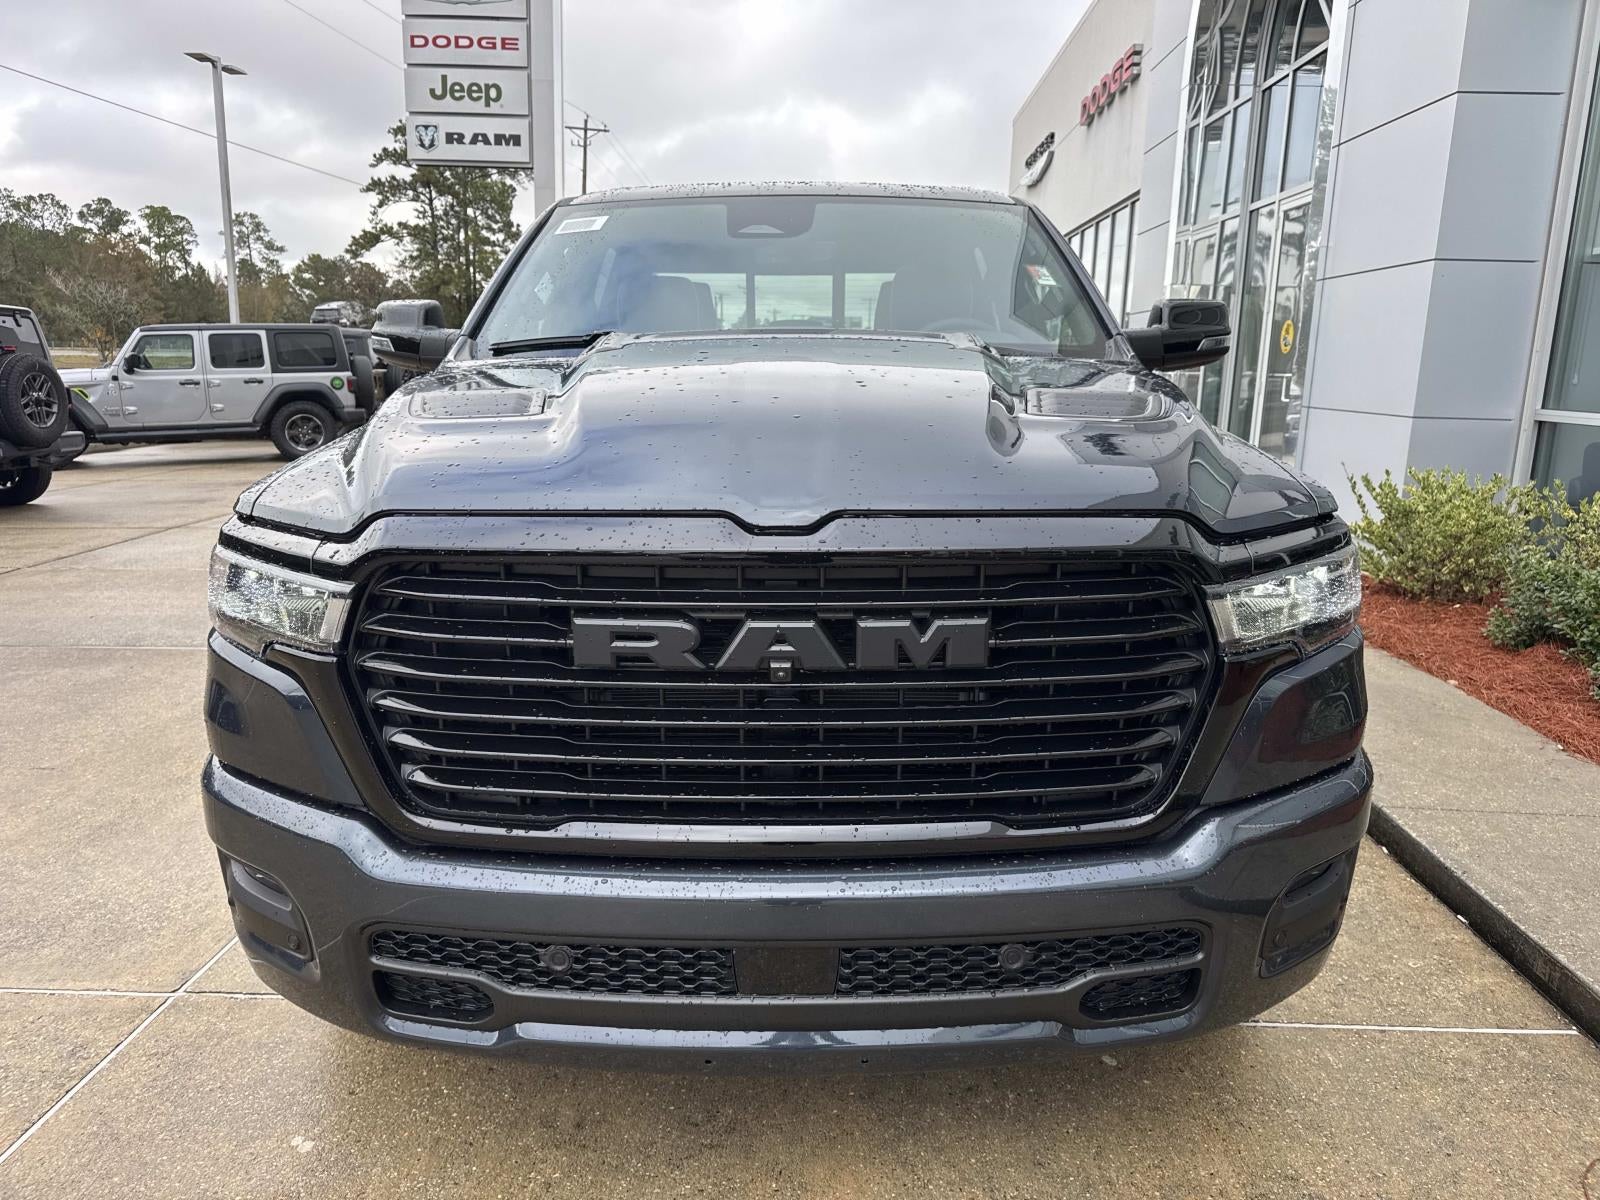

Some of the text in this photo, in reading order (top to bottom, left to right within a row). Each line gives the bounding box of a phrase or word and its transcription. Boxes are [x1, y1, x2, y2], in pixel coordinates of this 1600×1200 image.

[410, 35, 519, 51] DODGE
[429, 74, 503, 107] Jeep
[1080, 44, 1144, 126] DODGE
[445, 132, 521, 146] RAM
[573, 616, 990, 670] RAM
